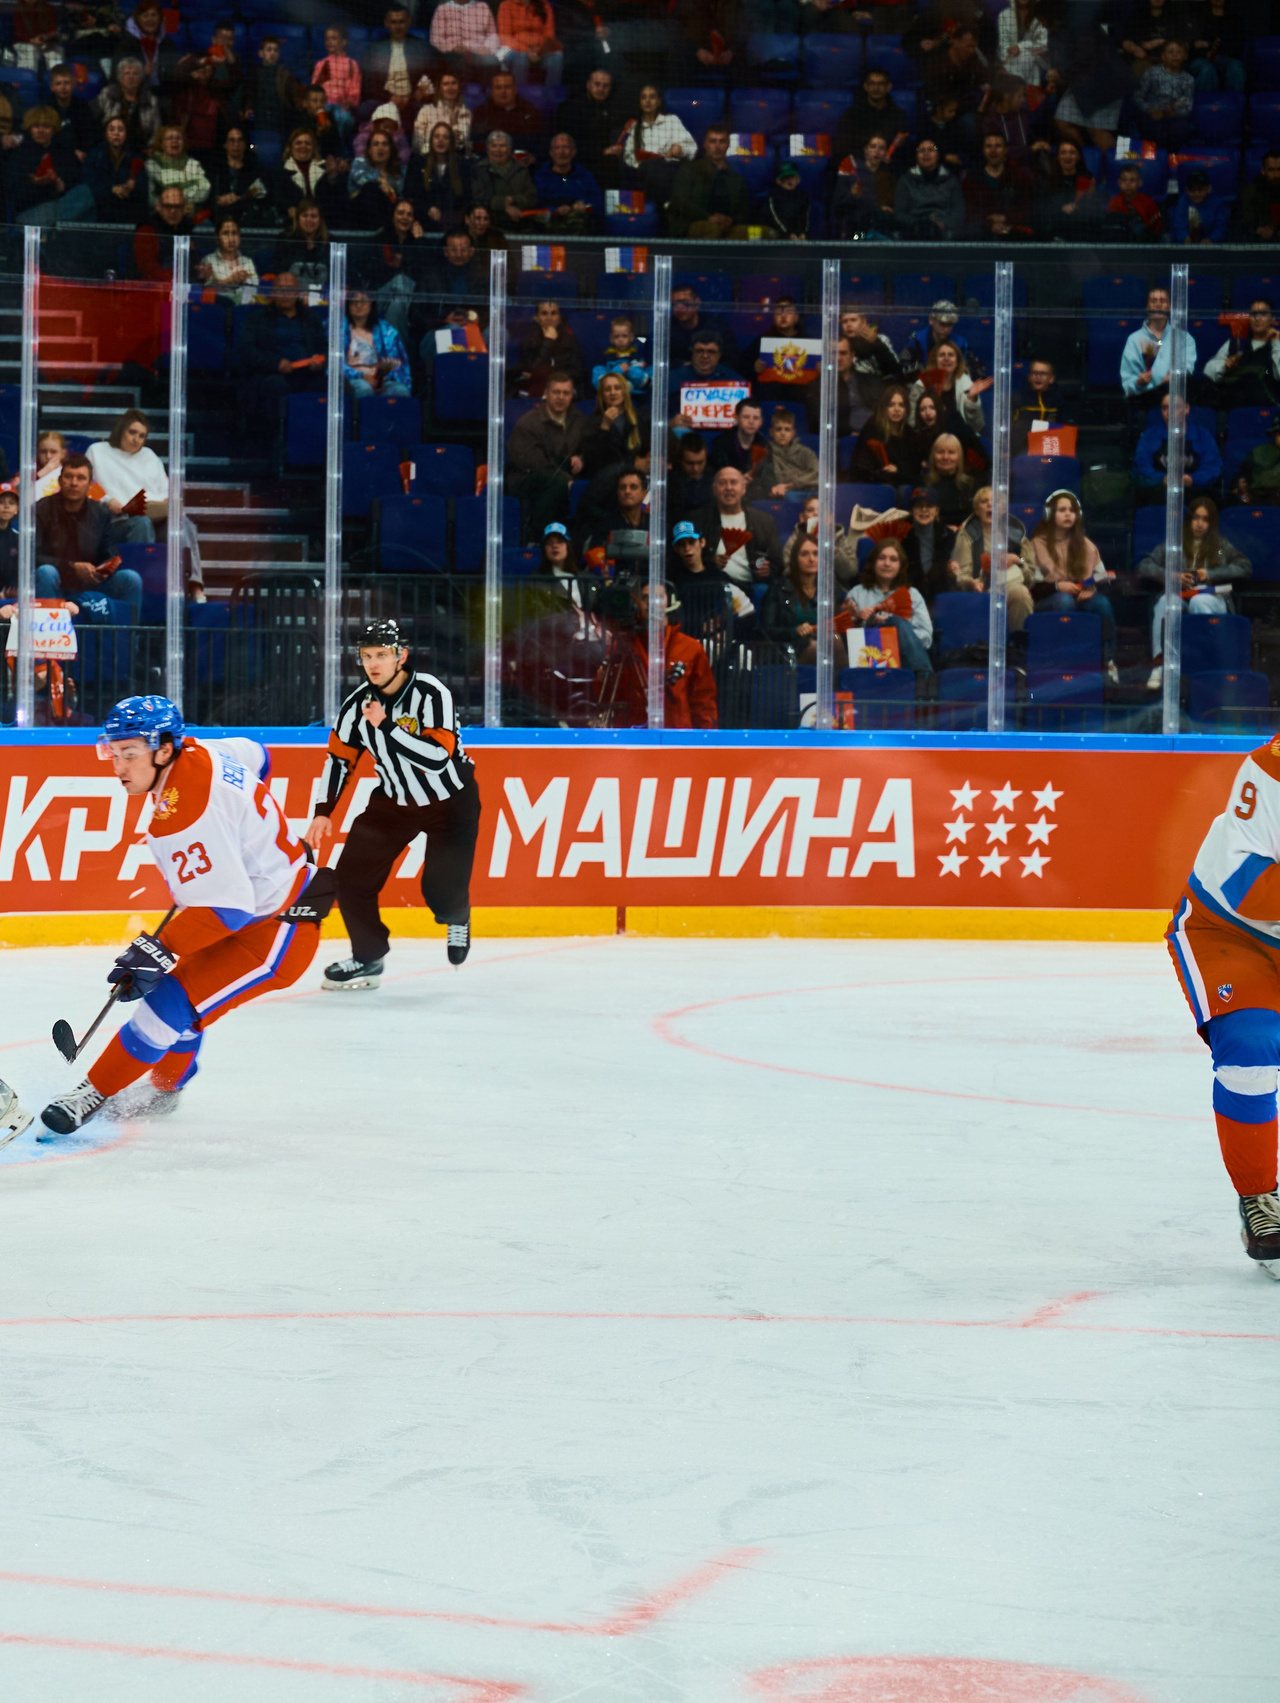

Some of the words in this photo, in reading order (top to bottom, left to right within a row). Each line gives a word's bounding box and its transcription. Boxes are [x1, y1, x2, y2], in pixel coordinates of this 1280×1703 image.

[1234, 780, 1257, 821] 9
[488, 776, 916, 878] МАШИНА
[171, 841, 213, 885] 23
[131, 935, 180, 973] BAUE
